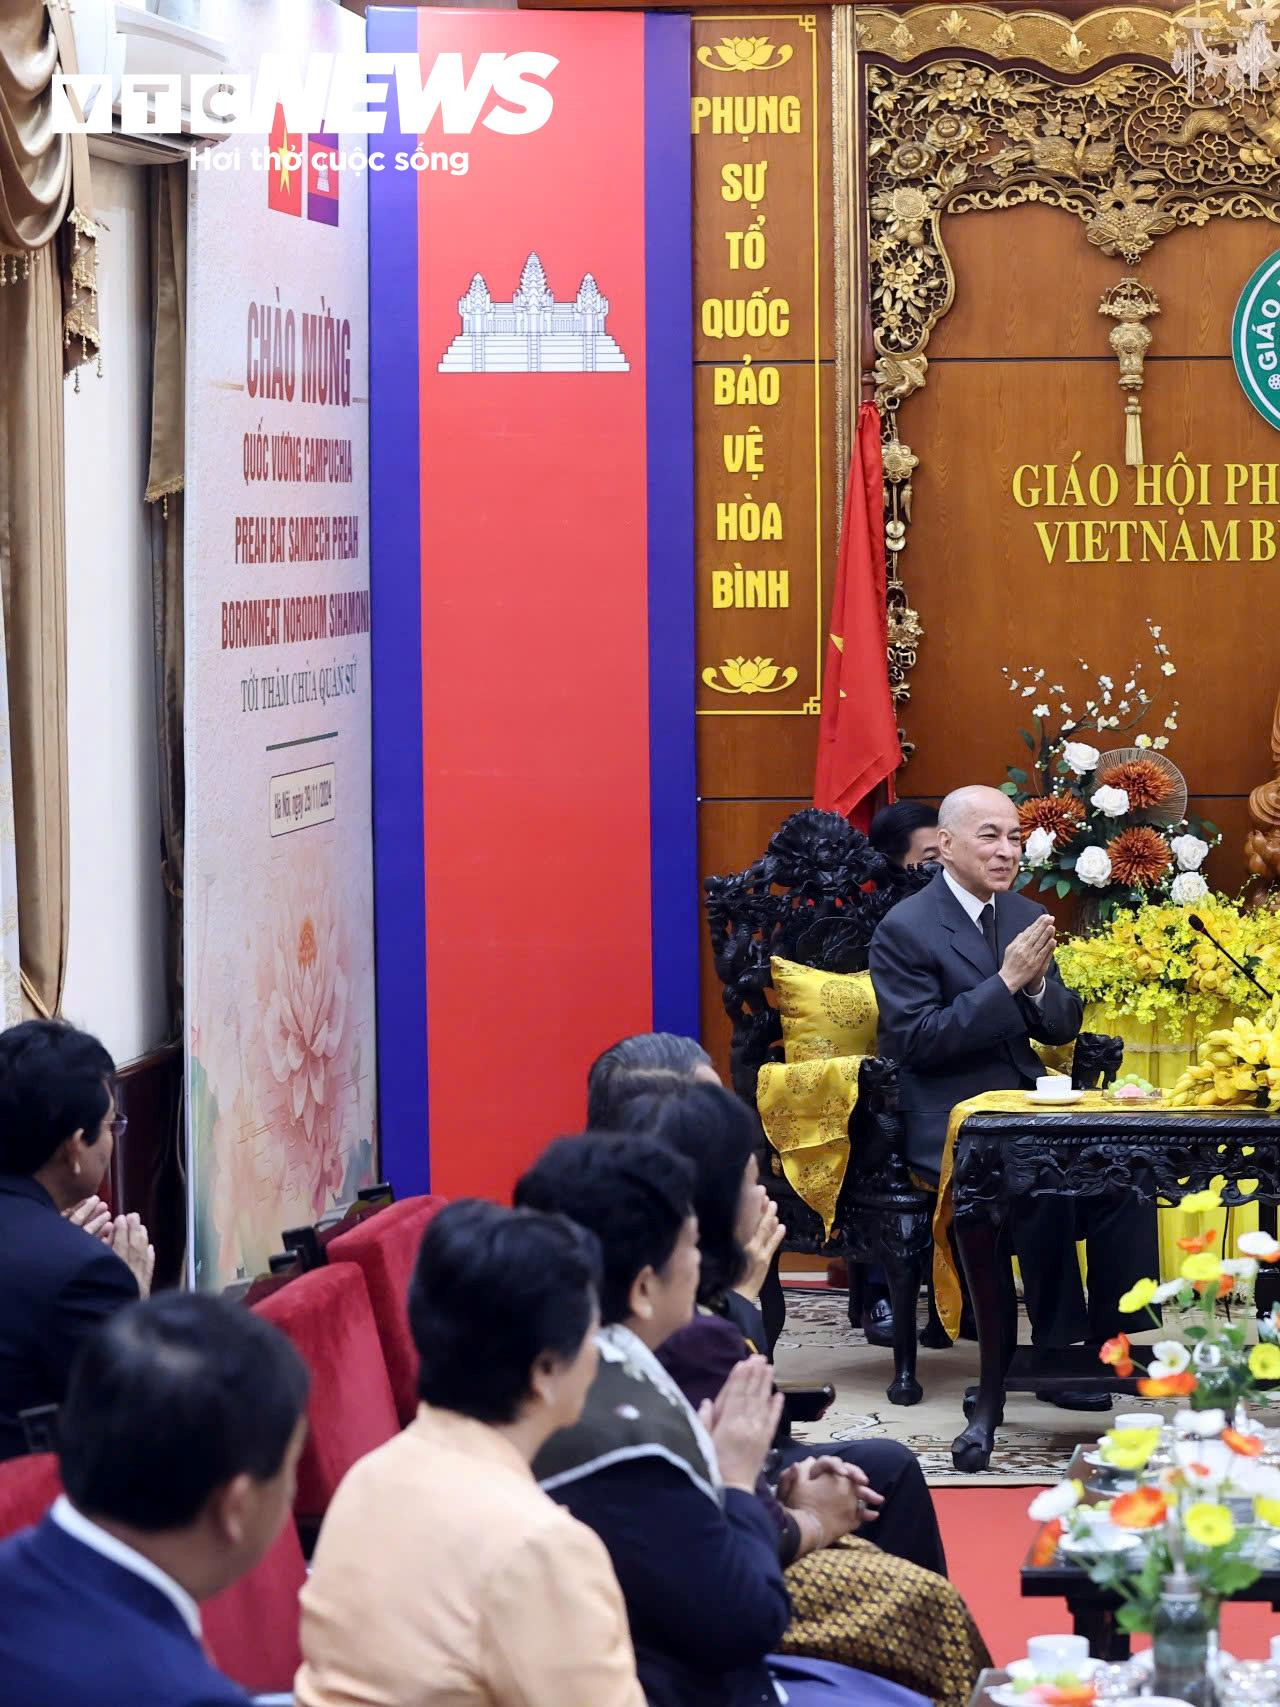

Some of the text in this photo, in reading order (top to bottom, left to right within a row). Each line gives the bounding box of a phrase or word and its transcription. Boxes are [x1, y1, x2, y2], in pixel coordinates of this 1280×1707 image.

[691, 95, 801, 143] PHỤNG
[721, 160, 768, 209] SỰ
[725, 215, 765, 270] TỔ
[701, 287, 789, 338] QUỐC
[1252, 299, 1280, 371] GIÁO
[247, 286, 350, 407] CHÀO MỪNG
[714, 353, 780, 405] BẢO
[243, 416, 353, 486] QUỐC VƯƠNG CAMPUCHIA
[723, 425, 764, 480] VỆ
[1012, 450, 1119, 507] GIÁO
[1133, 451, 1213, 515] HỘI
[235, 515, 359, 564] PREAH BAT SAMDECH PREAH
[716, 493, 783, 541] HÒA
[1034, 520, 1241, 564] VIETNAM
[712, 562, 789, 609] BÌNH
[221, 590, 369, 650] BOROMNEAT NORODOM SIHAMONI
